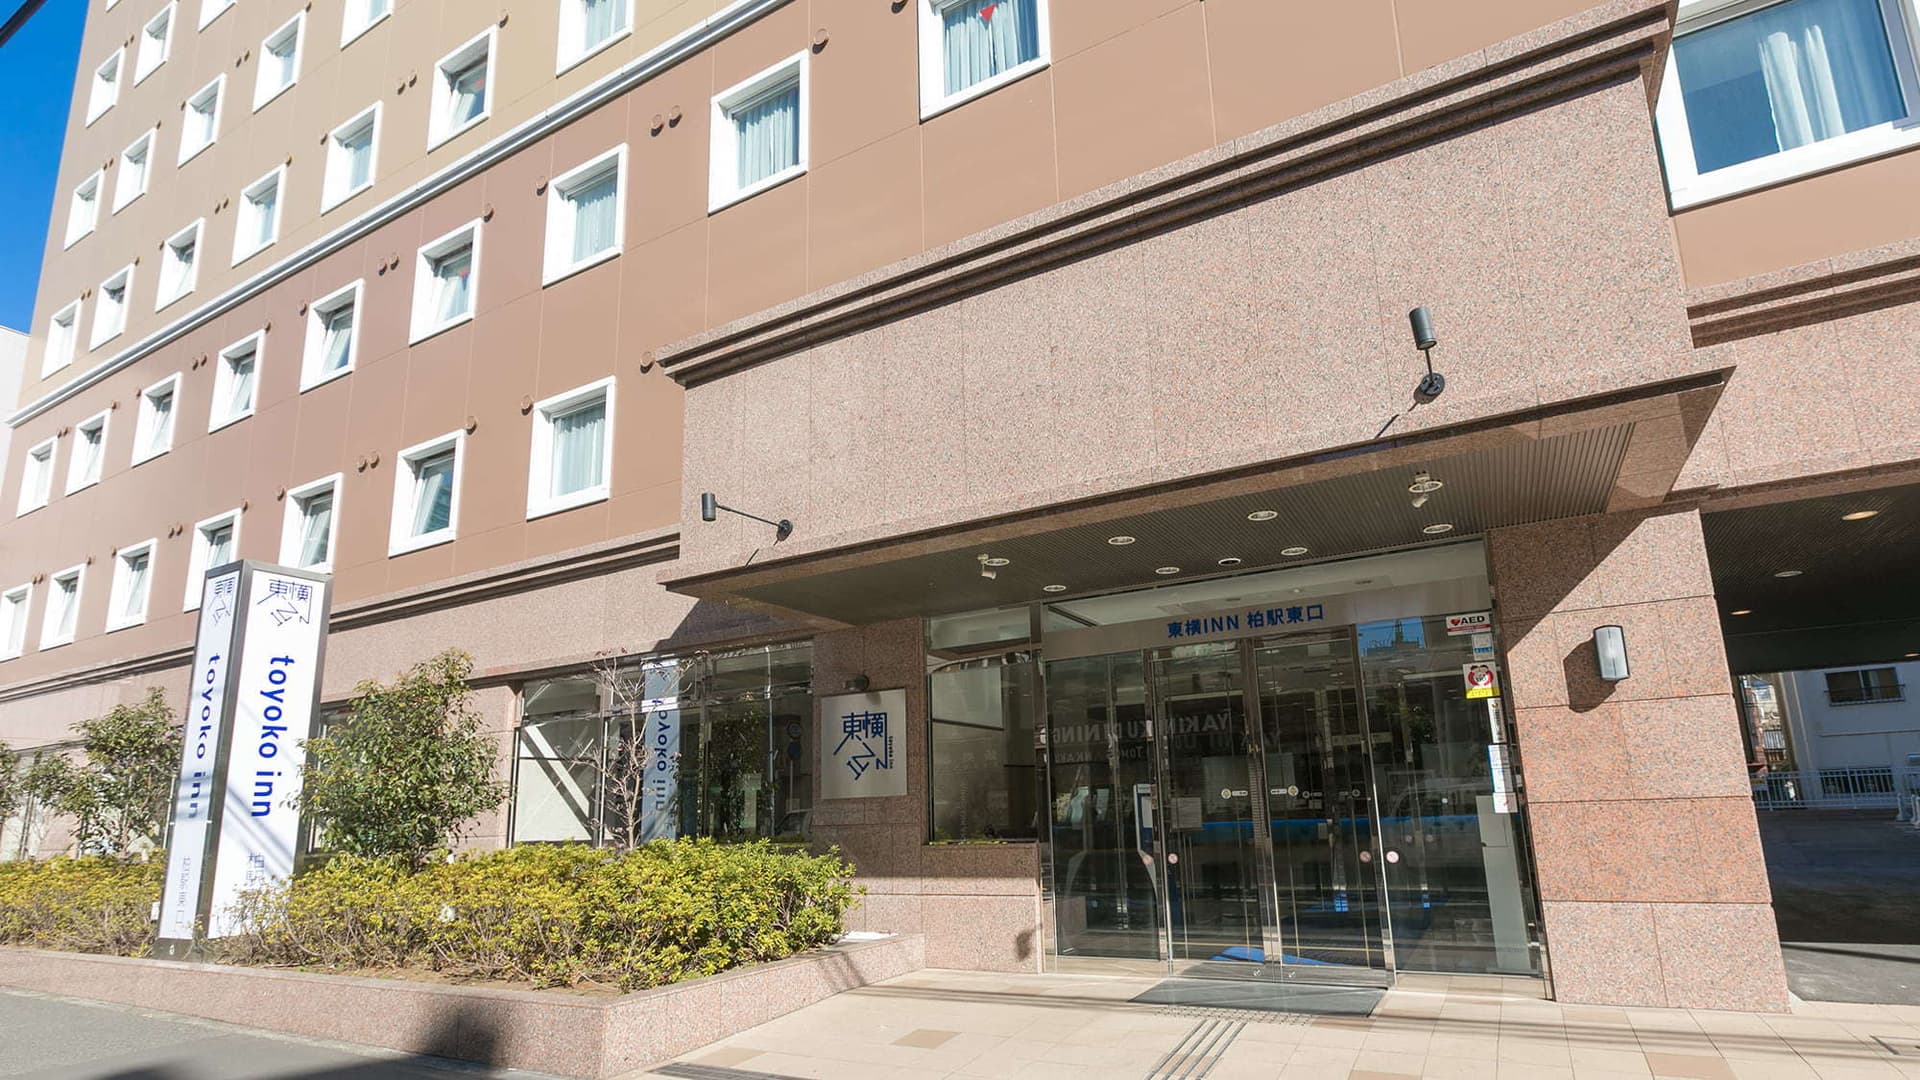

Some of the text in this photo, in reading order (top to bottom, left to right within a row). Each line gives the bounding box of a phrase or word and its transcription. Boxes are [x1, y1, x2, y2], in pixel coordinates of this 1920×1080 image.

[1168, 604, 1324, 638] 東横INN 柏駅東口
[1461, 616, 1485, 625] AED
[188, 653, 220, 819] toyoko inn
[251, 655, 295, 817] toyoko inn
